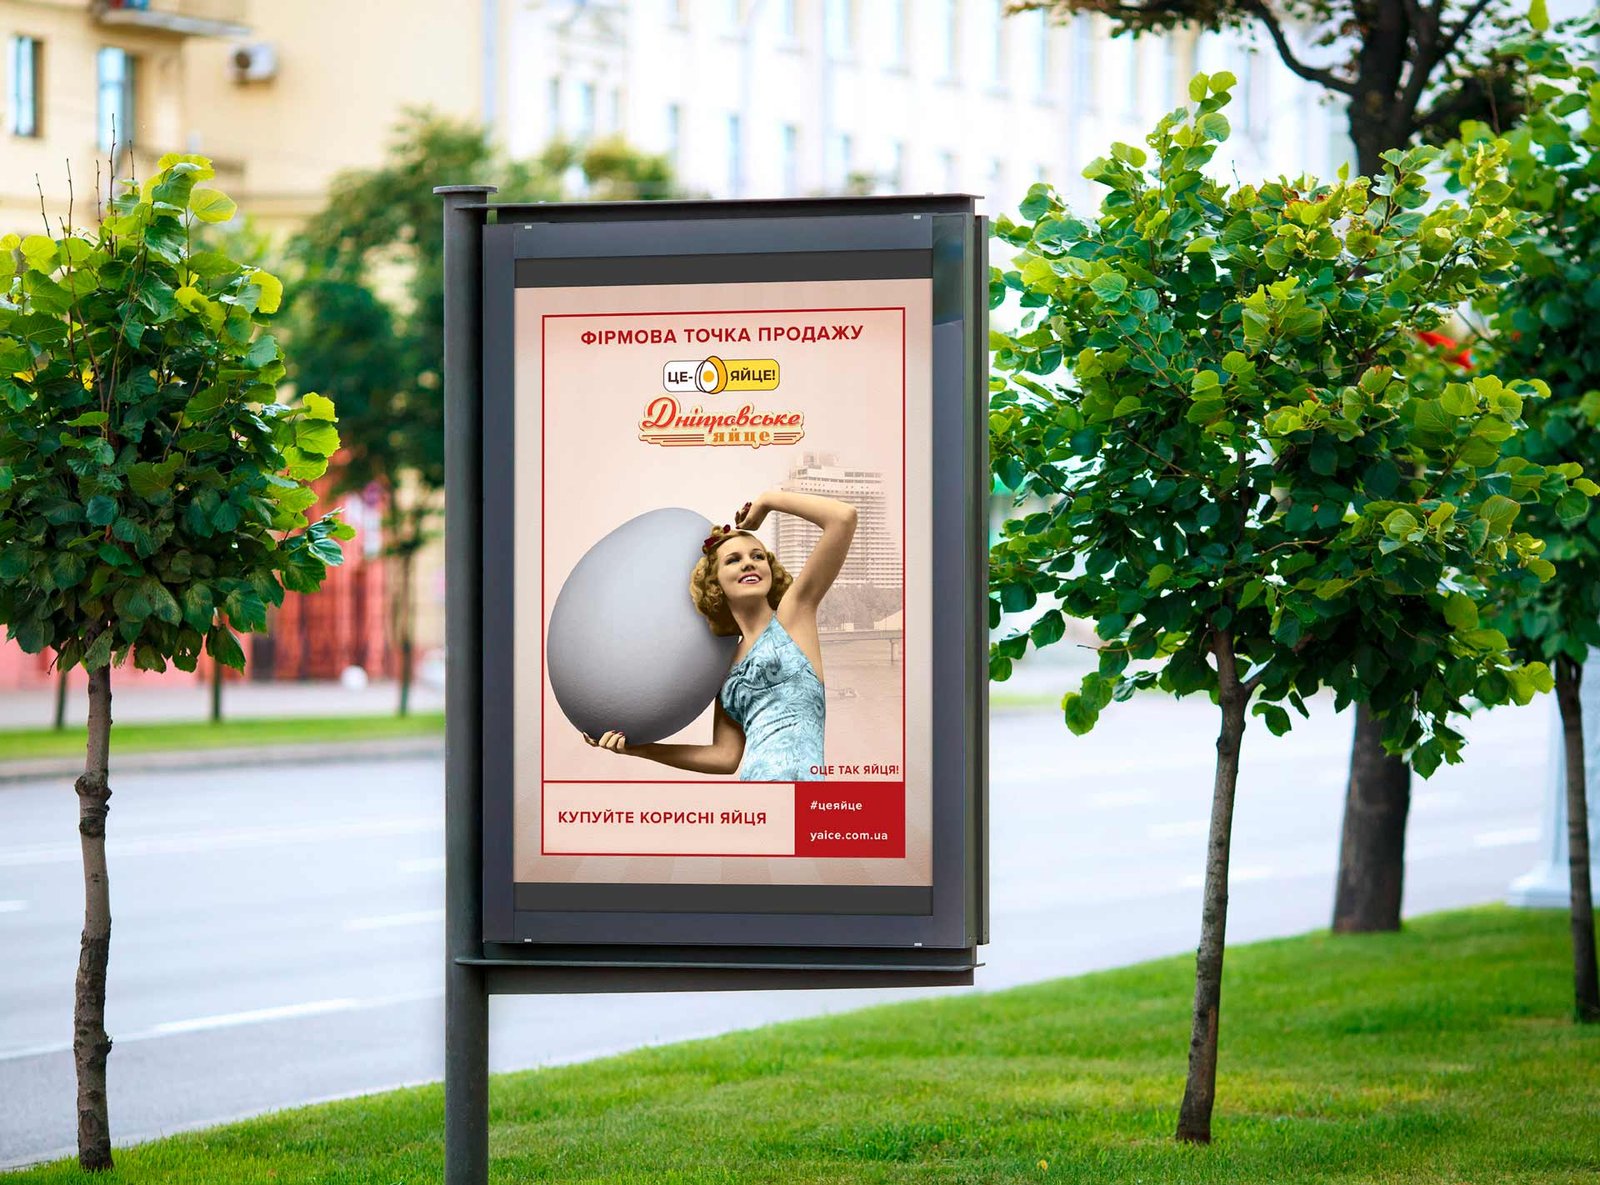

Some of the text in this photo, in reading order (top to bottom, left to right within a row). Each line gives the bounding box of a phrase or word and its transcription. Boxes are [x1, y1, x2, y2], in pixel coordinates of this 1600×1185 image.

[580, 325, 864, 345] ФІРМОВА ТОЧКА ПРОДАЖУ
[730, 369, 776, 384] ЯЙЦЕ!
[641, 396, 801, 434] Дніпровське
[712, 428, 771, 446] яйце
[809, 763, 900, 777] ОЦЕ ТАК ЯЙЦЯ!
[809, 800, 863, 813] #цеяйце
[558, 809, 767, 826] КУПУЙТЕ КОРИСНІ ЯЙЦЯ
[809, 829, 889, 842] yaice.com.ua
